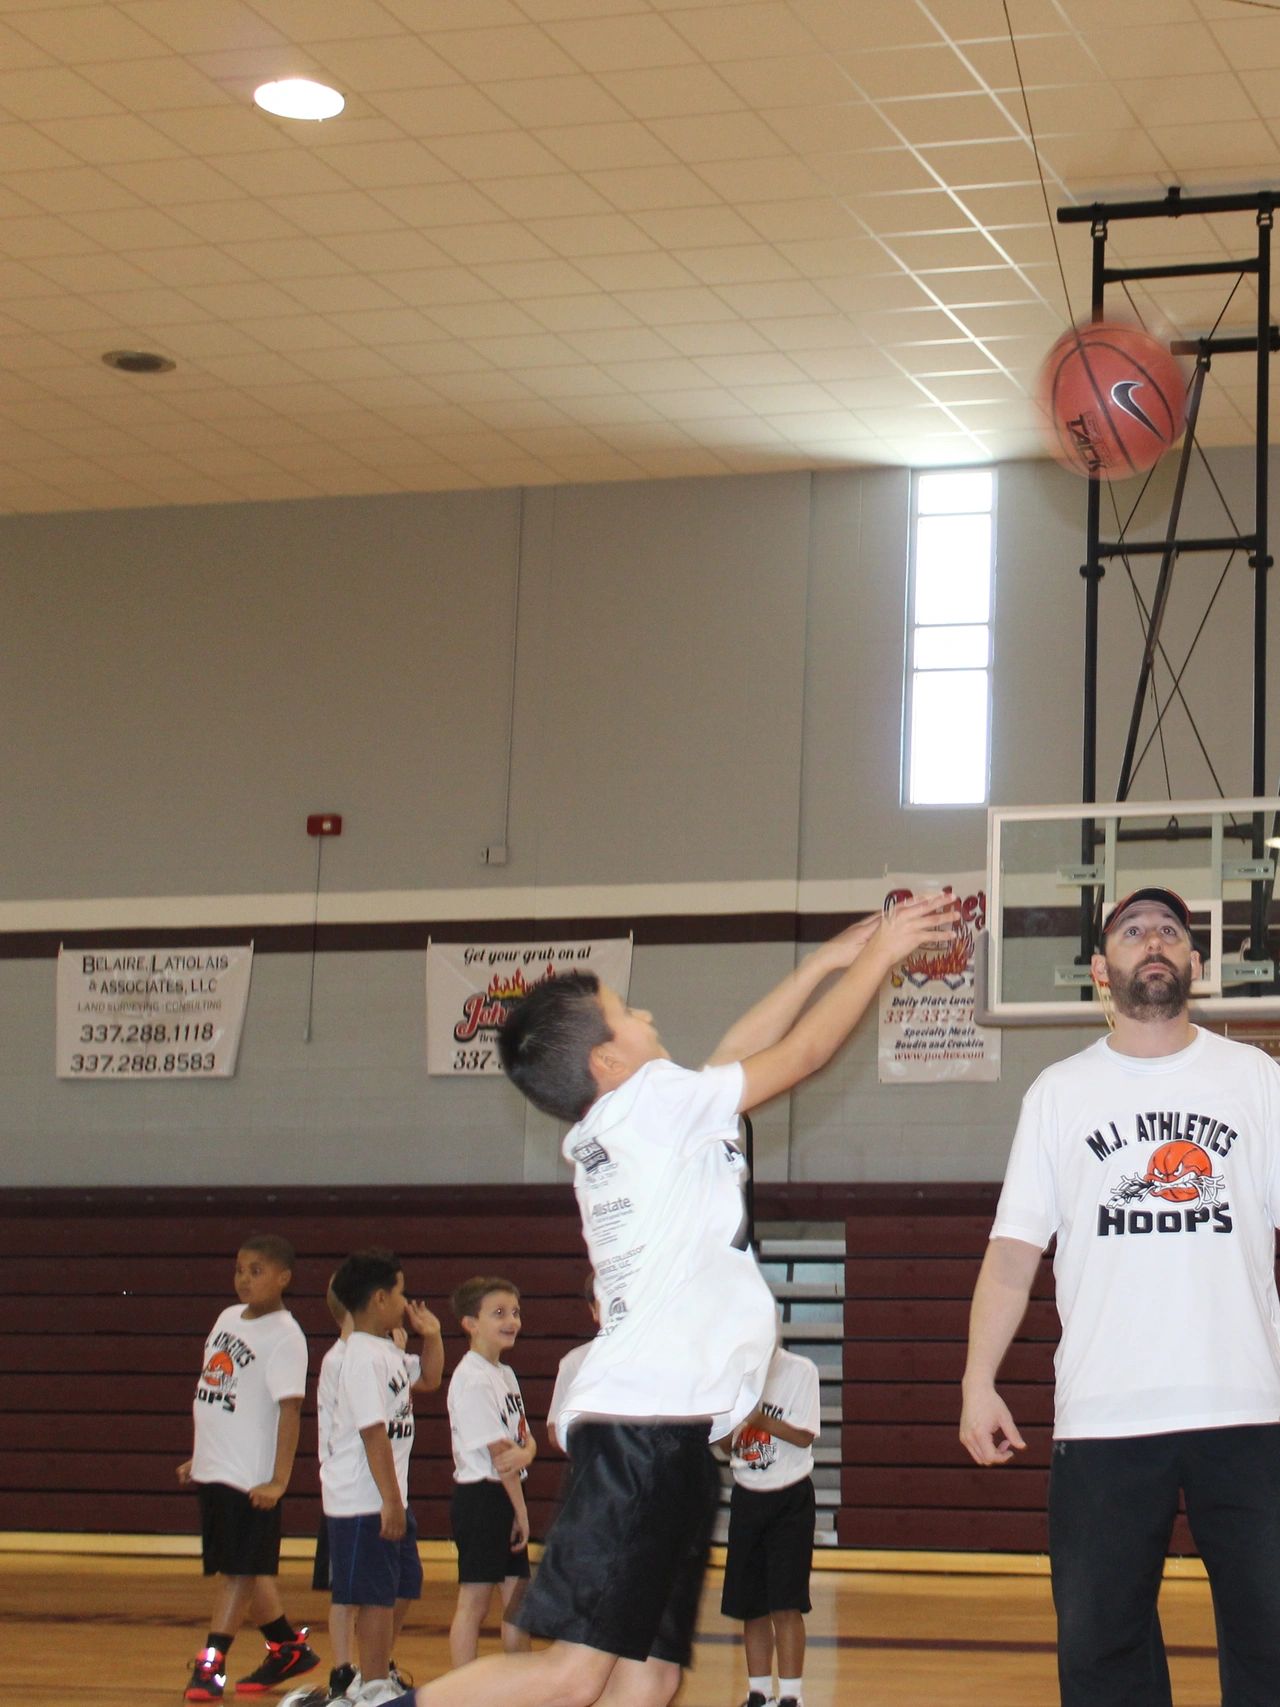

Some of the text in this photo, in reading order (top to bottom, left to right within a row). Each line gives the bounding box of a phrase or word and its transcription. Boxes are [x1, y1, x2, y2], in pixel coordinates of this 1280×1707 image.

[152, 955, 229, 974] LATIOLAIS
[464, 947, 486, 965] Get
[488, 949, 520, 965] your
[523, 947, 555, 964] grub
[558, 949, 574, 960] on
[191, 979, 218, 993] LLC
[165, 1000, 222, 1013] CONSULTING
[892, 996, 919, 1008] Daily
[920, 996, 947, 1006] Plate
[80, 1023, 214, 1043] 337.288.1118
[904, 1026, 946, 1040] Specialty
[929, 1040, 945, 1050] and
[70, 1053, 216, 1073] 337.288.8583
[1085, 1112, 1238, 1162] M.J. ATHLETICS
[1097, 1202, 1233, 1237] HOOPS
